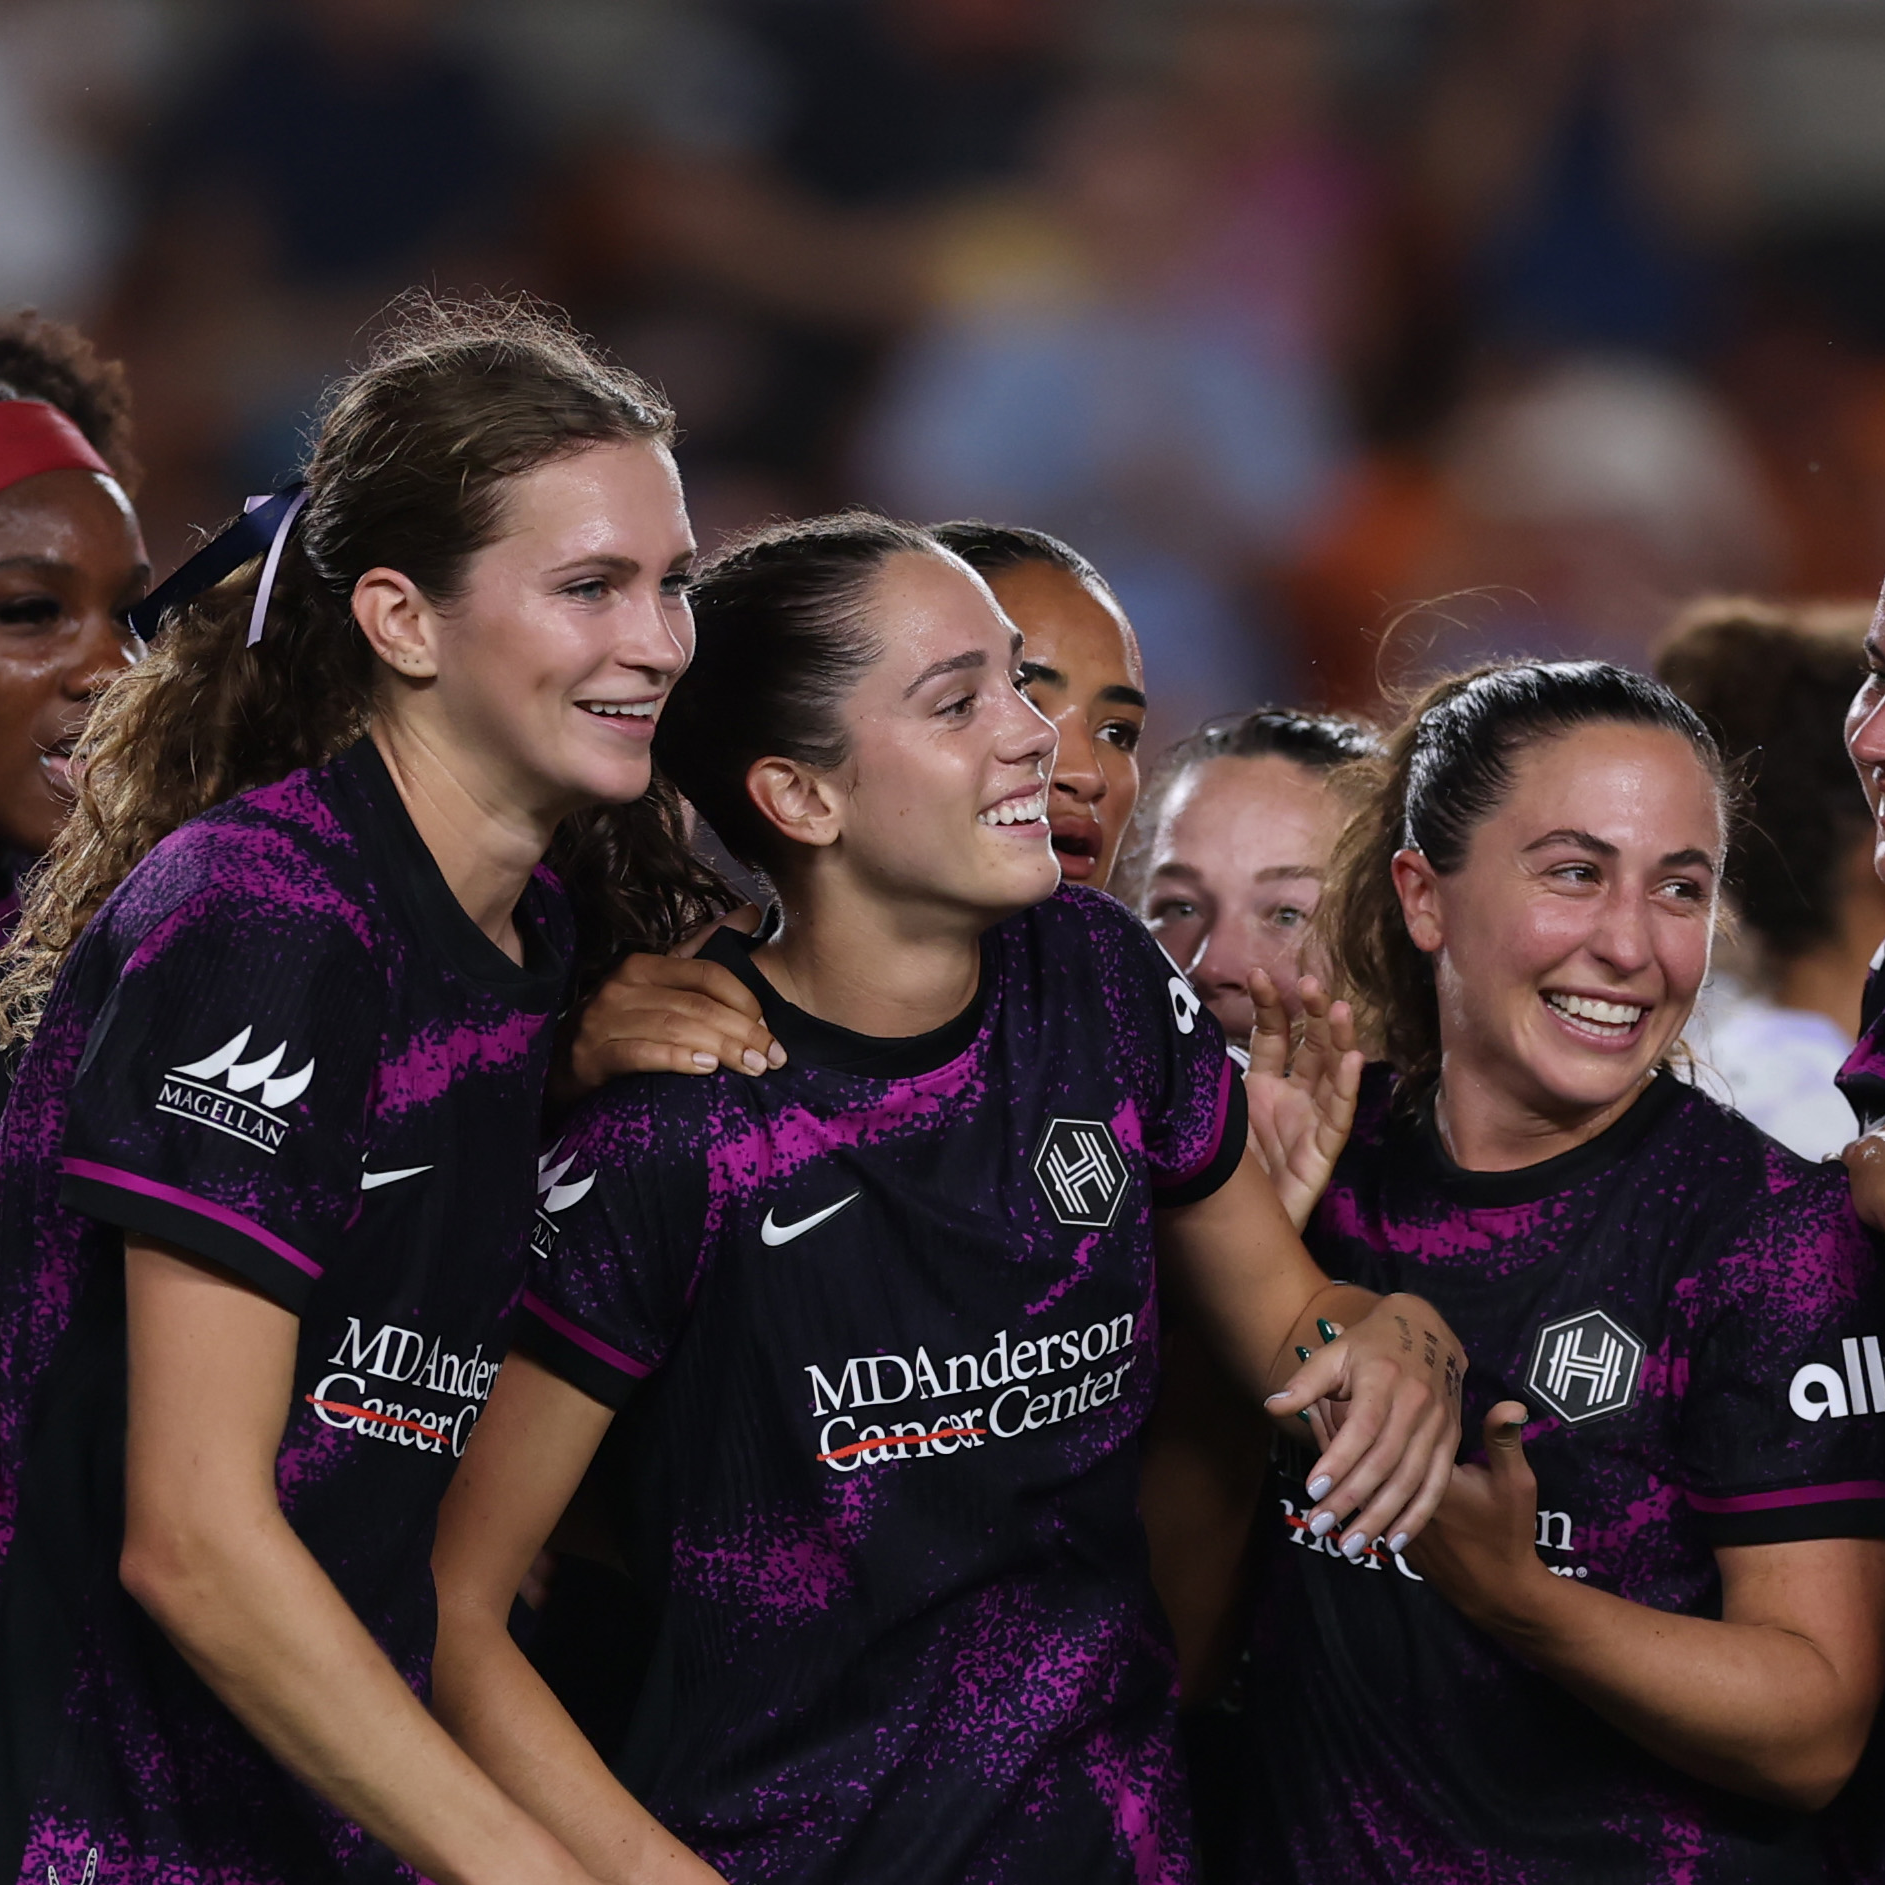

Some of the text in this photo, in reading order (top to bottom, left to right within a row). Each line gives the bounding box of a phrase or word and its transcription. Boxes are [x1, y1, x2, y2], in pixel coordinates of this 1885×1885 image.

[158, 1083, 286, 1147] MAGELLAN
[327, 1316, 502, 1401] MD Ander
[804, 1313, 1134, 1417] MD Anderson
[314, 1372, 453, 1455] Cancer
[819, 1408, 984, 1472] Cancer
